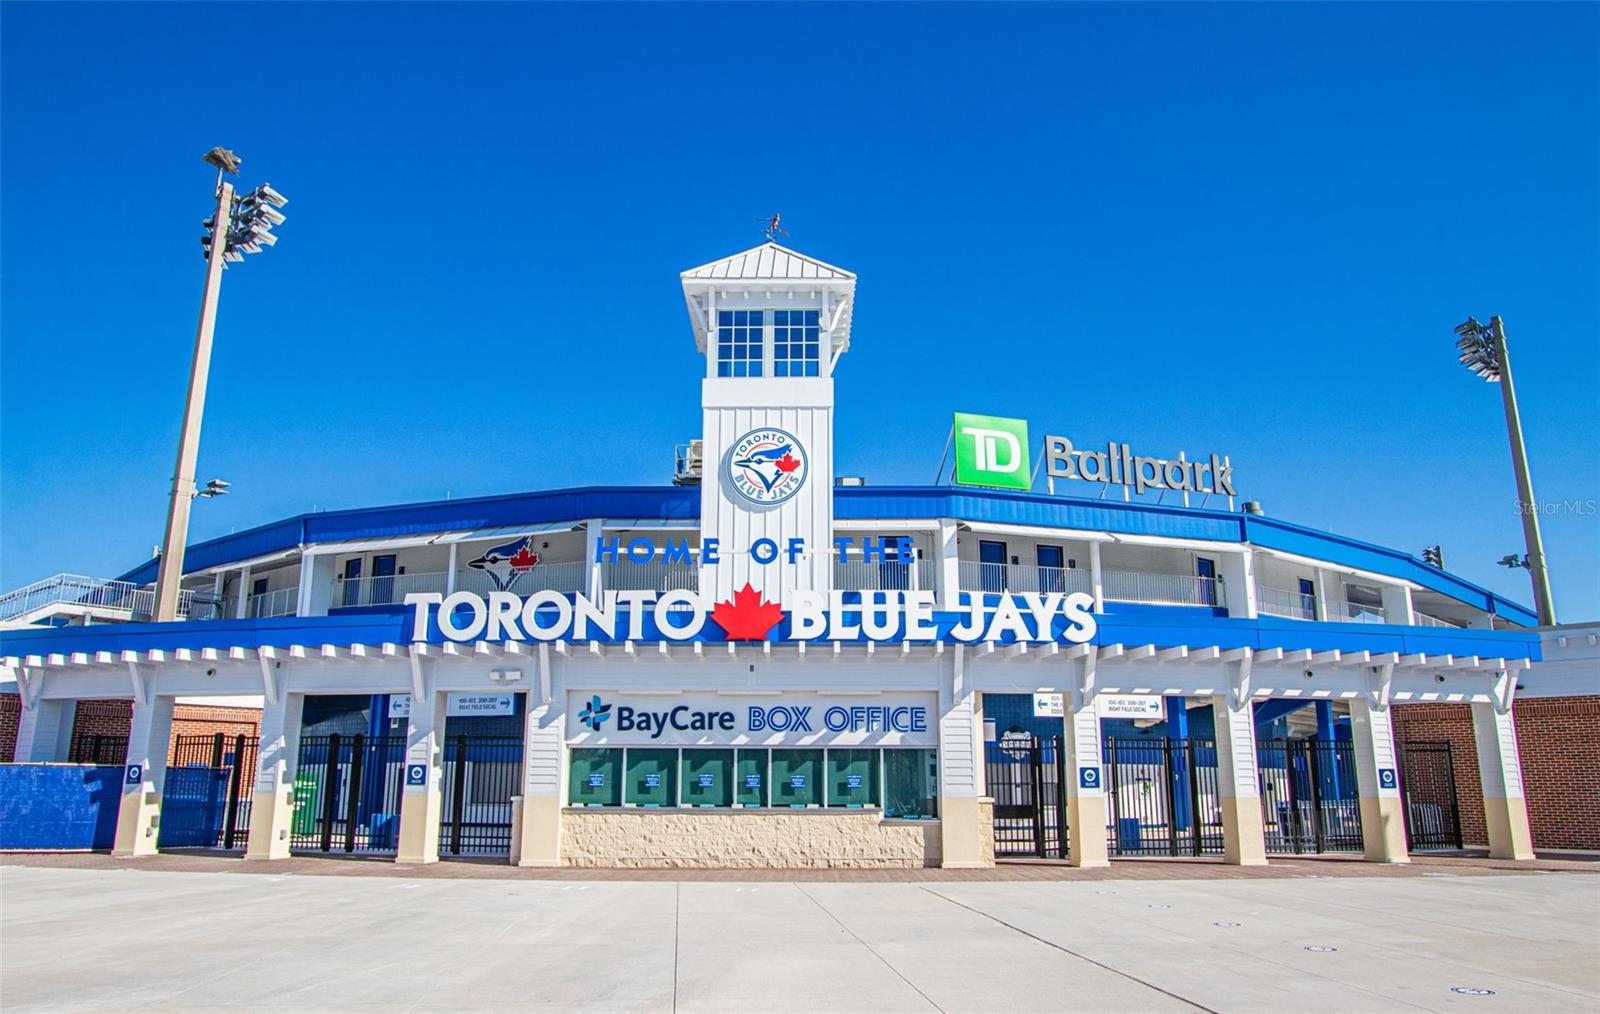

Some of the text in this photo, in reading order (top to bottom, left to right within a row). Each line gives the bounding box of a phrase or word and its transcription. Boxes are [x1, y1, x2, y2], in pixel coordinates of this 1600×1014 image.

[735, 433, 785, 457] TORONTO
[962, 427, 1237, 496] TD Ballpark
[734, 474, 800, 500] BLUE JAYS
[595, 537, 915, 565] HOME OF THE
[404, 588, 1098, 643] TORONTO BLUE JAYS
[617, 705, 927, 738] BayCare BOX OFFICE
